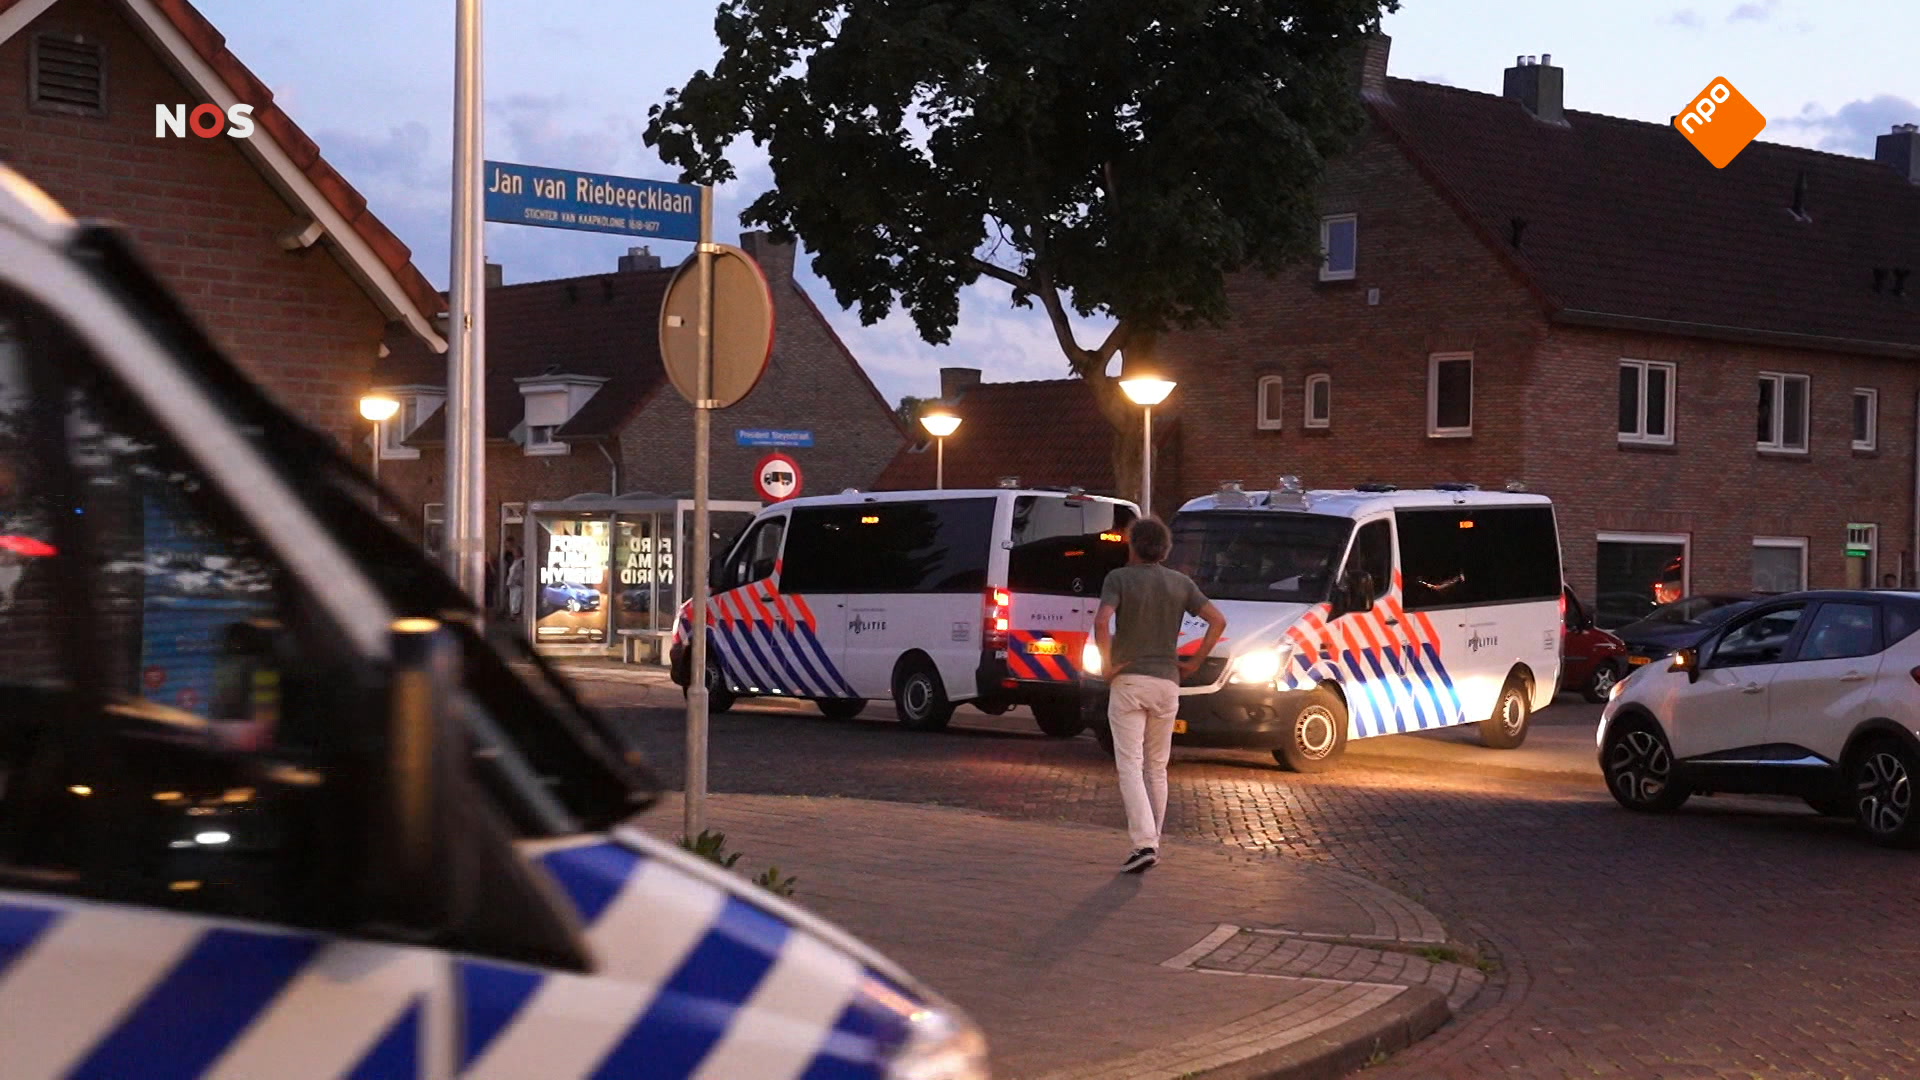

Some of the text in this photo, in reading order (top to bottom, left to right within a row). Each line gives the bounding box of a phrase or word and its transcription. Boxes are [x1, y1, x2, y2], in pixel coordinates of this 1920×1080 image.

[489, 167, 692, 214] Jan van Riebeecklaan
[561, 211, 576, 223] VAN
